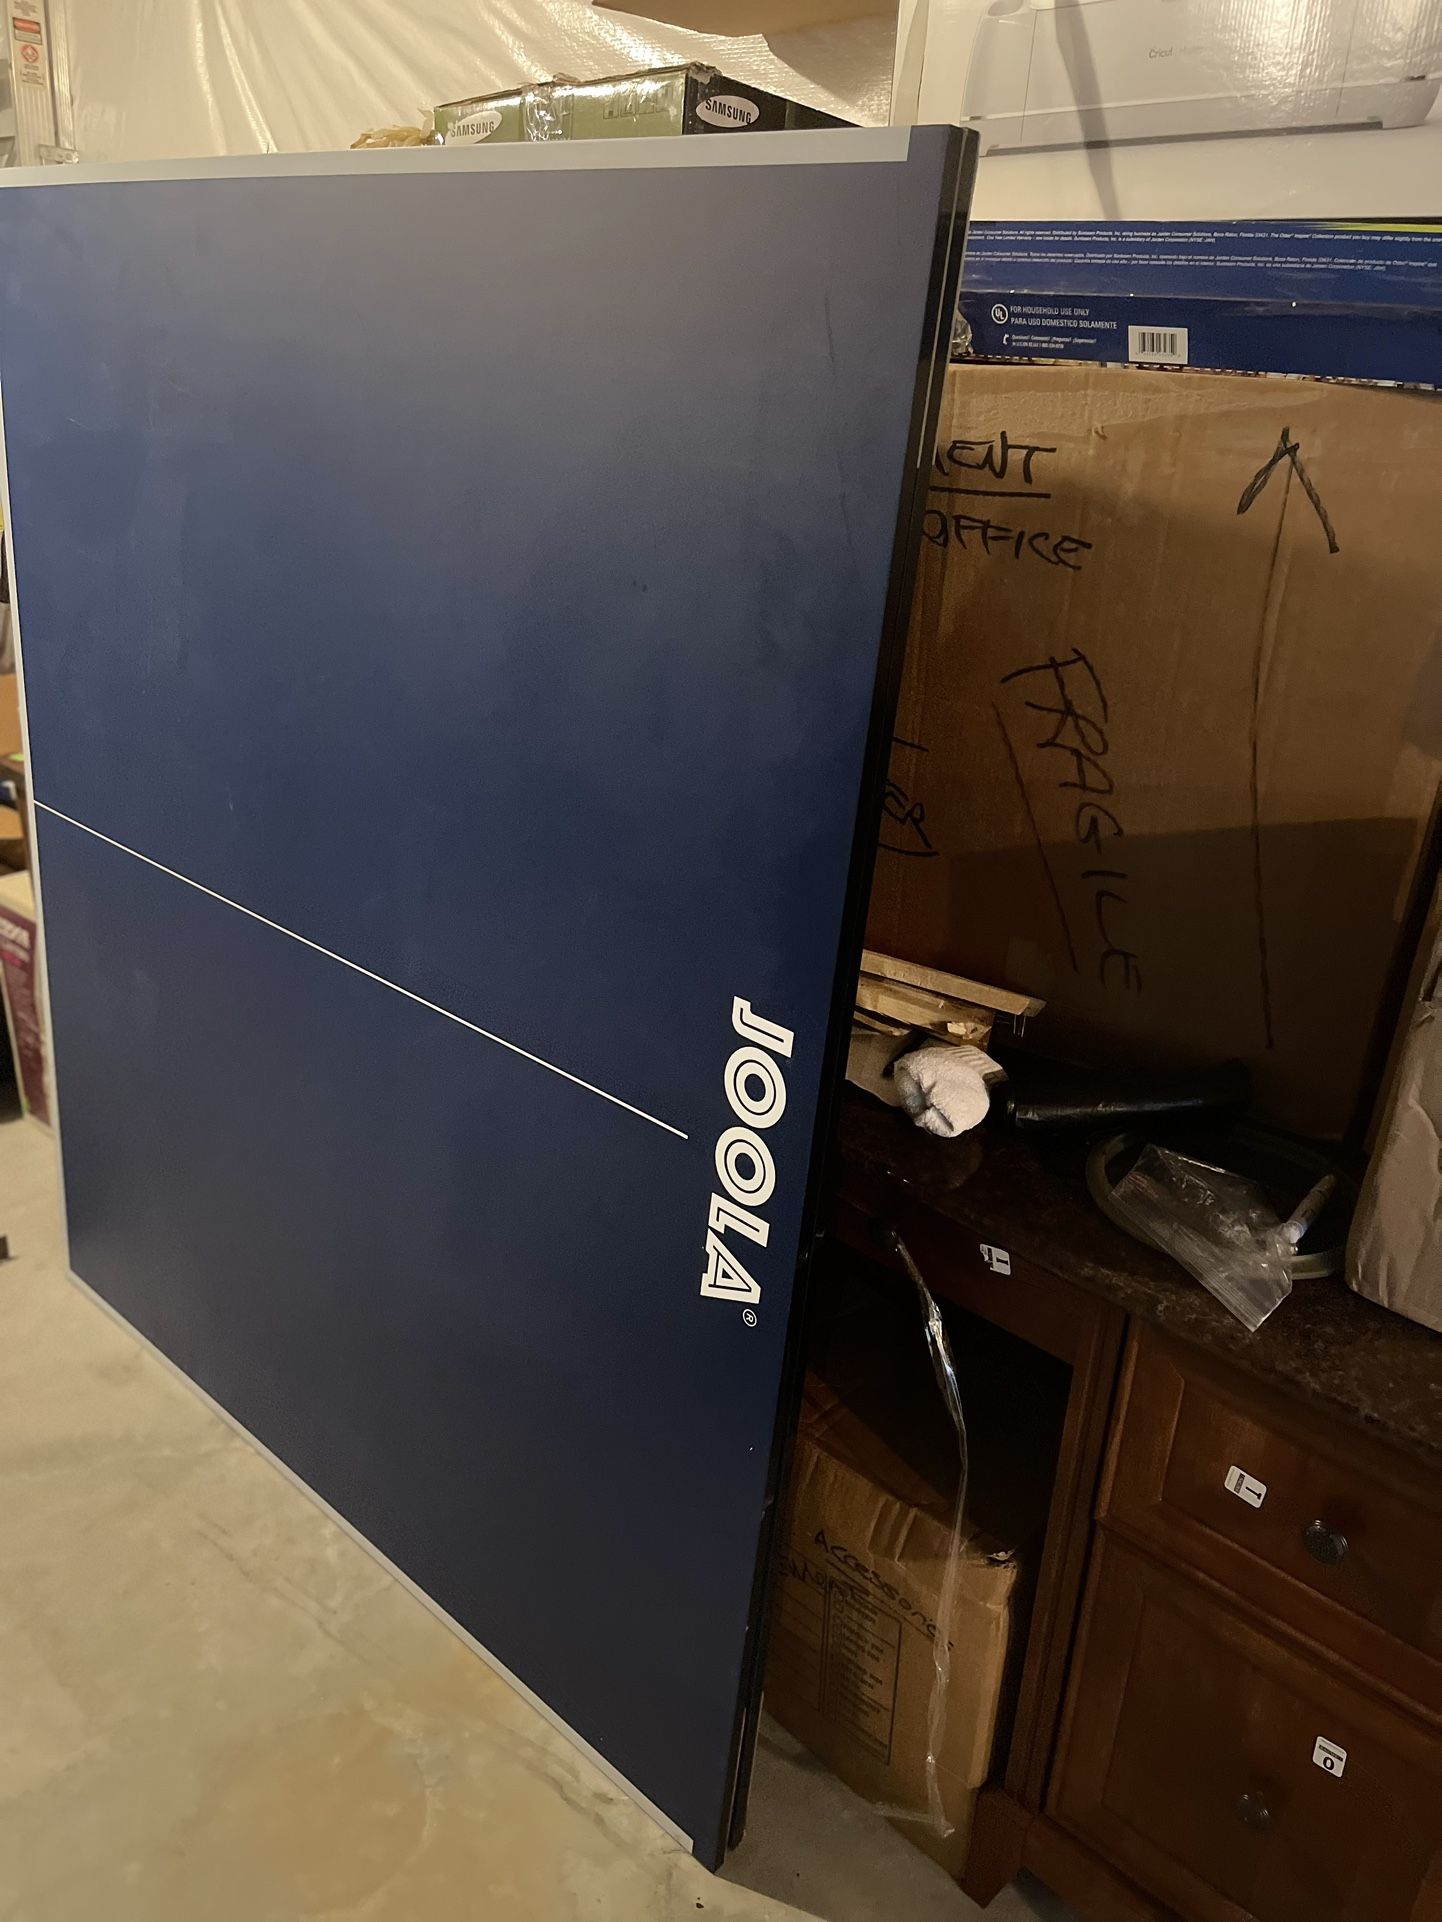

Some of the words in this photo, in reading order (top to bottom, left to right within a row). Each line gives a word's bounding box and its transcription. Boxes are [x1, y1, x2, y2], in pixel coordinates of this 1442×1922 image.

[705, 98, 752, 125] SAMSUNG
[451, 121, 495, 138] SAMSUNG
[1010, 305, 1022, 313] FOR
[1023, 306, 1059, 315] HOUSEHOLD
[1060, 308, 1073, 316] USE
[1074, 308, 1090, 316] ONLY
[1041, 319, 1078, 328] DOMESTICO
[1079, 320, 1118, 329] SOLAMENTE
[1001, 647, 1142, 994] FRAGILE
[699, 995, 795, 1305] JOOLA
